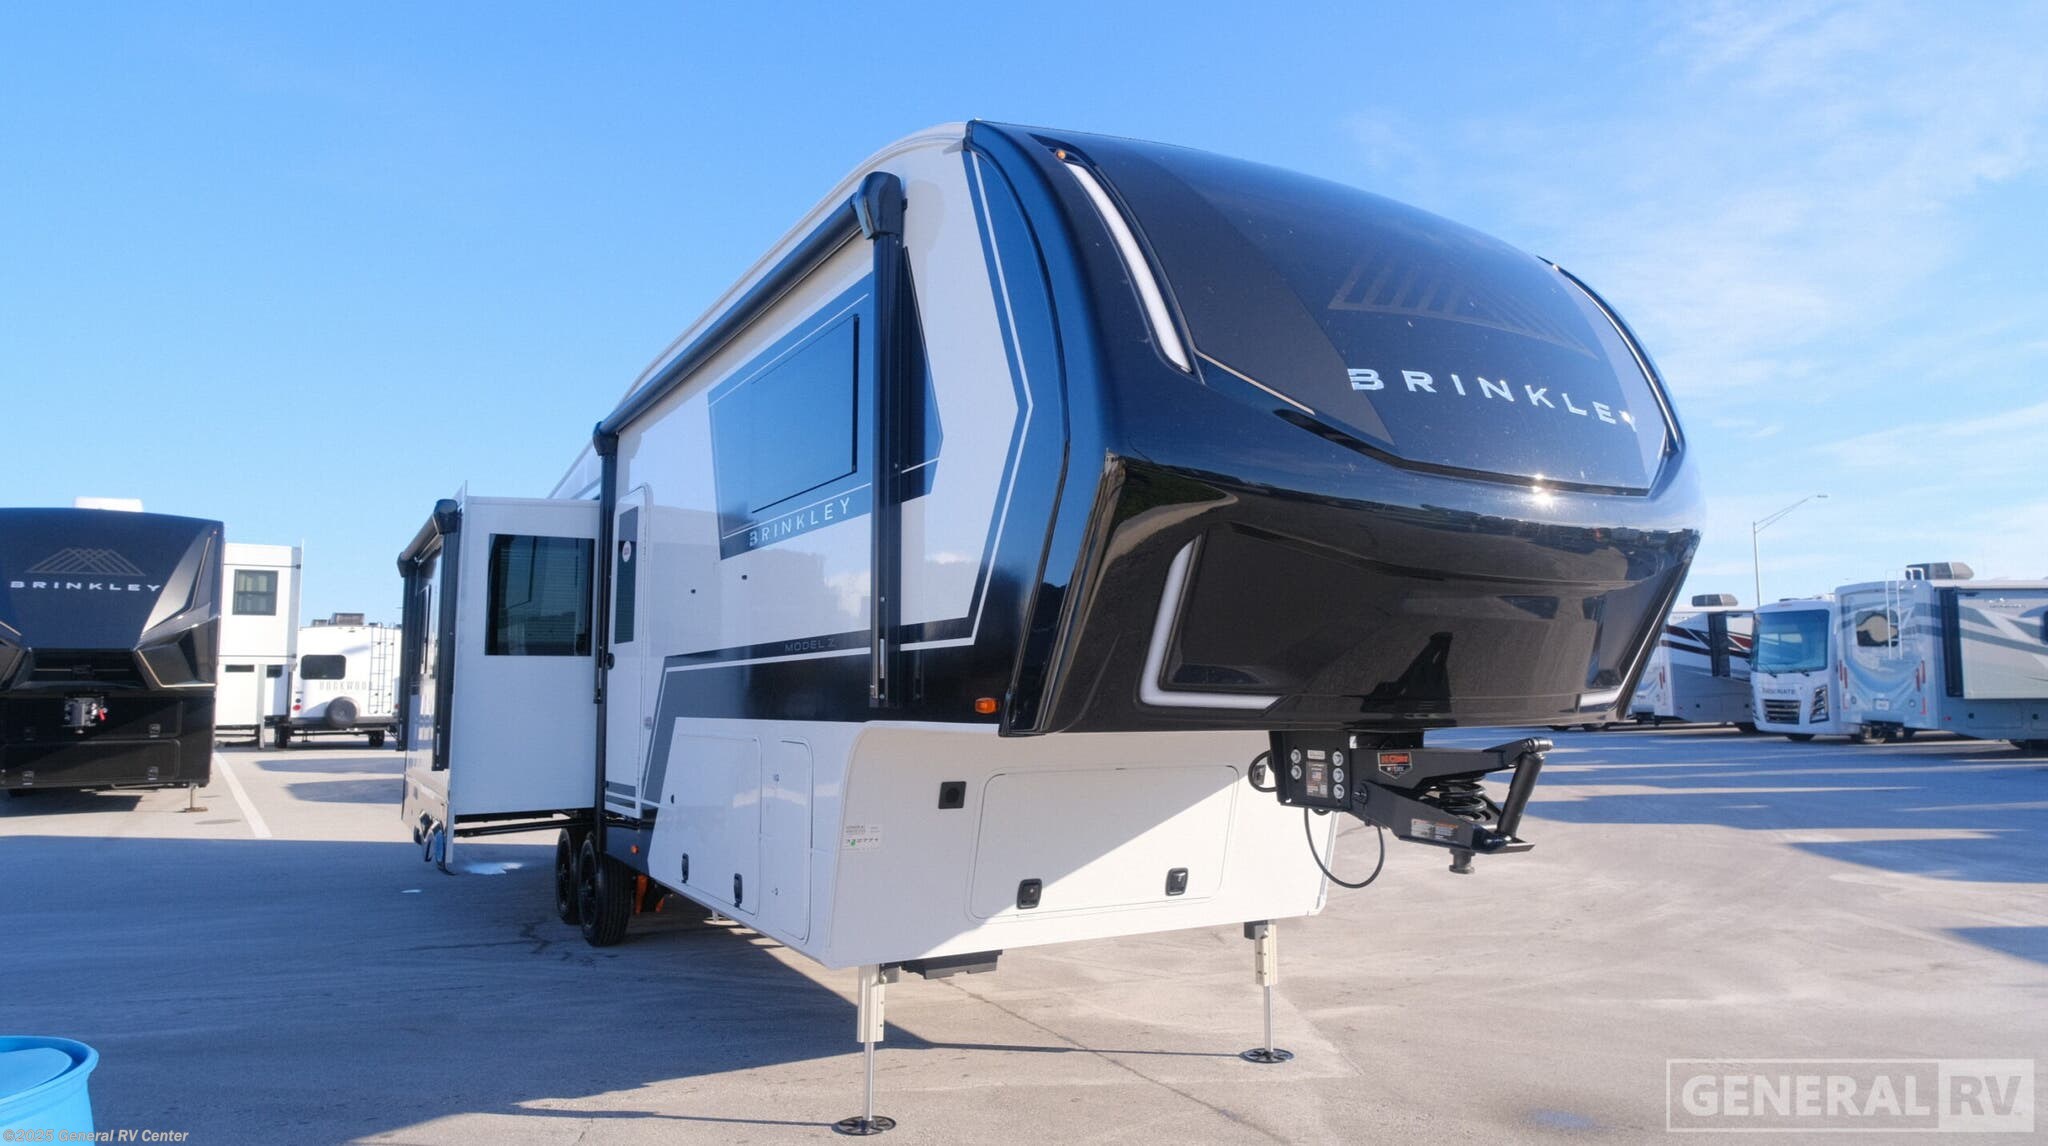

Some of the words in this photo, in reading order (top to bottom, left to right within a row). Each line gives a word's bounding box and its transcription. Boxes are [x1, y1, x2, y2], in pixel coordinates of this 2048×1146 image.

[1346, 367, 1638, 433] BRINKLEY
[748, 496, 851, 547] BRINKLEY
[10, 580, 161, 593] BRINKLEY
[784, 639, 824, 653] MODEL
[827, 638, 836, 648] Z
